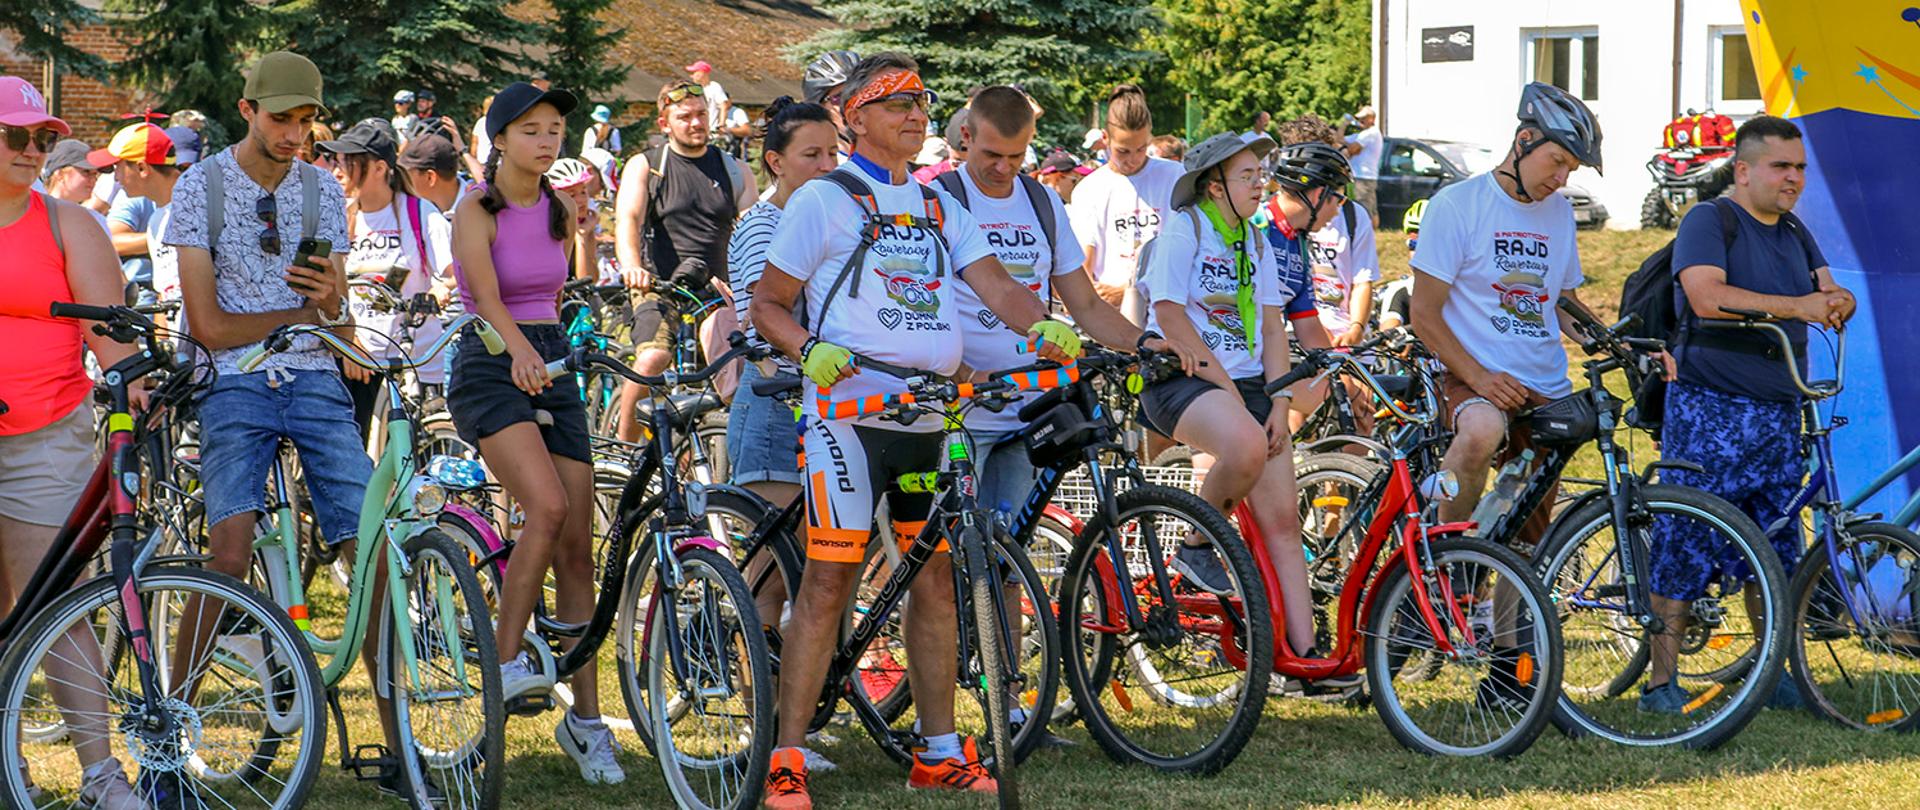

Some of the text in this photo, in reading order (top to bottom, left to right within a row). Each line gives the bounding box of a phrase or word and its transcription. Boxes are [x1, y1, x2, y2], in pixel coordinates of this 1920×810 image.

[987, 230, 1037, 247] AJD
[872, 240, 930, 264] Rowerowy
[1494, 239, 1549, 258] RAJD
[1493, 255, 1550, 279] Rowerowy
[906, 322, 914, 331] Z
[811, 538, 855, 549] SPONSOR
